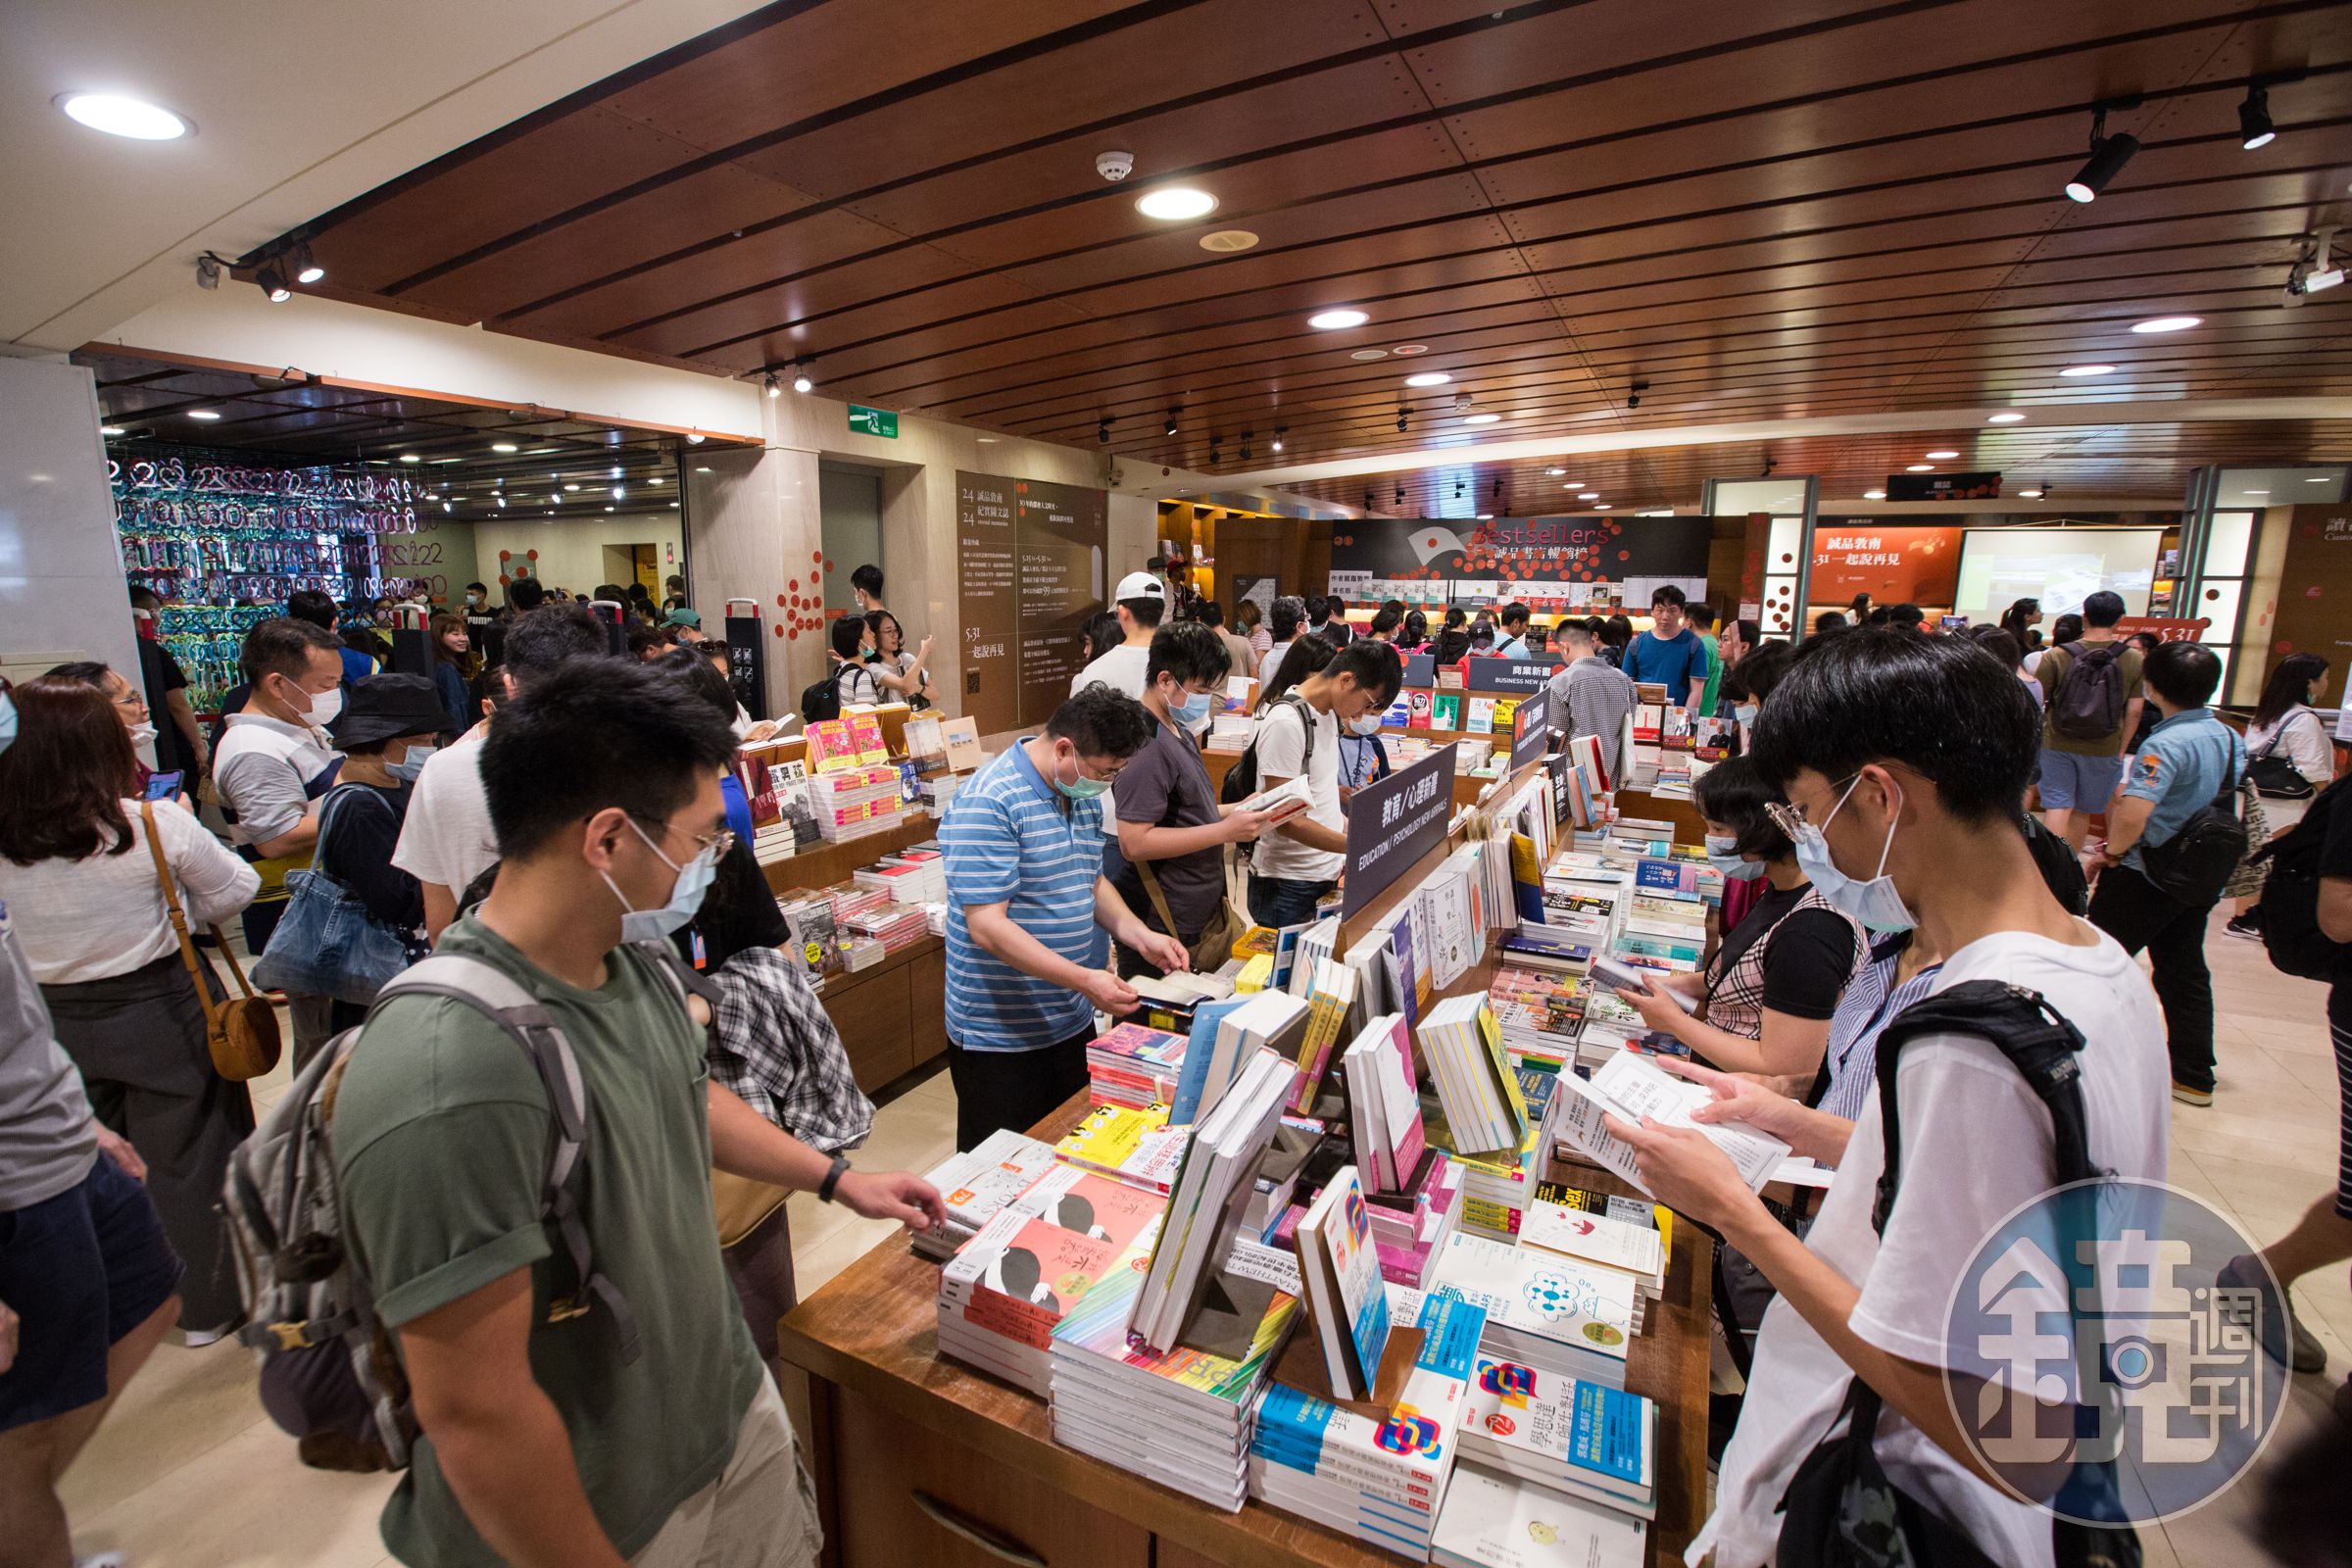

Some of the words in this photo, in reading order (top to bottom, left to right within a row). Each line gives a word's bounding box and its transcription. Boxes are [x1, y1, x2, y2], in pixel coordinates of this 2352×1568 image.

[962, 488, 974, 504] 24
[977, 492, 1003, 504] 誠品敦南
[963, 512, 975, 527] 24
[977, 506, 1009, 518] 紀實圖文誌
[1474, 524, 1610, 545] Bestsellers
[1827, 537, 1882, 551] 誠品敦南
[1813, 555, 1830, 566] .31
[1832, 553, 1901, 566] 一起說再見
[965, 627, 980, 642] 5.31
[966, 644, 1004, 659] 一起說再見
[1512, 666, 1551, 677] 商業新書
[1382, 770, 1440, 828] 教育/心理新書
[1358, 838, 1390, 871] EDUCATION
[1393, 816, 1422, 847] PSYCHOLOGY
[1420, 811, 1431, 828] NEW
[1430, 797, 1447, 822] ARRIVALS
[1559, 1187, 1583, 1211] Sex
[1235, 1263, 1298, 1291] MATTHEW
[1531, 1401, 1557, 1448] 學思達
